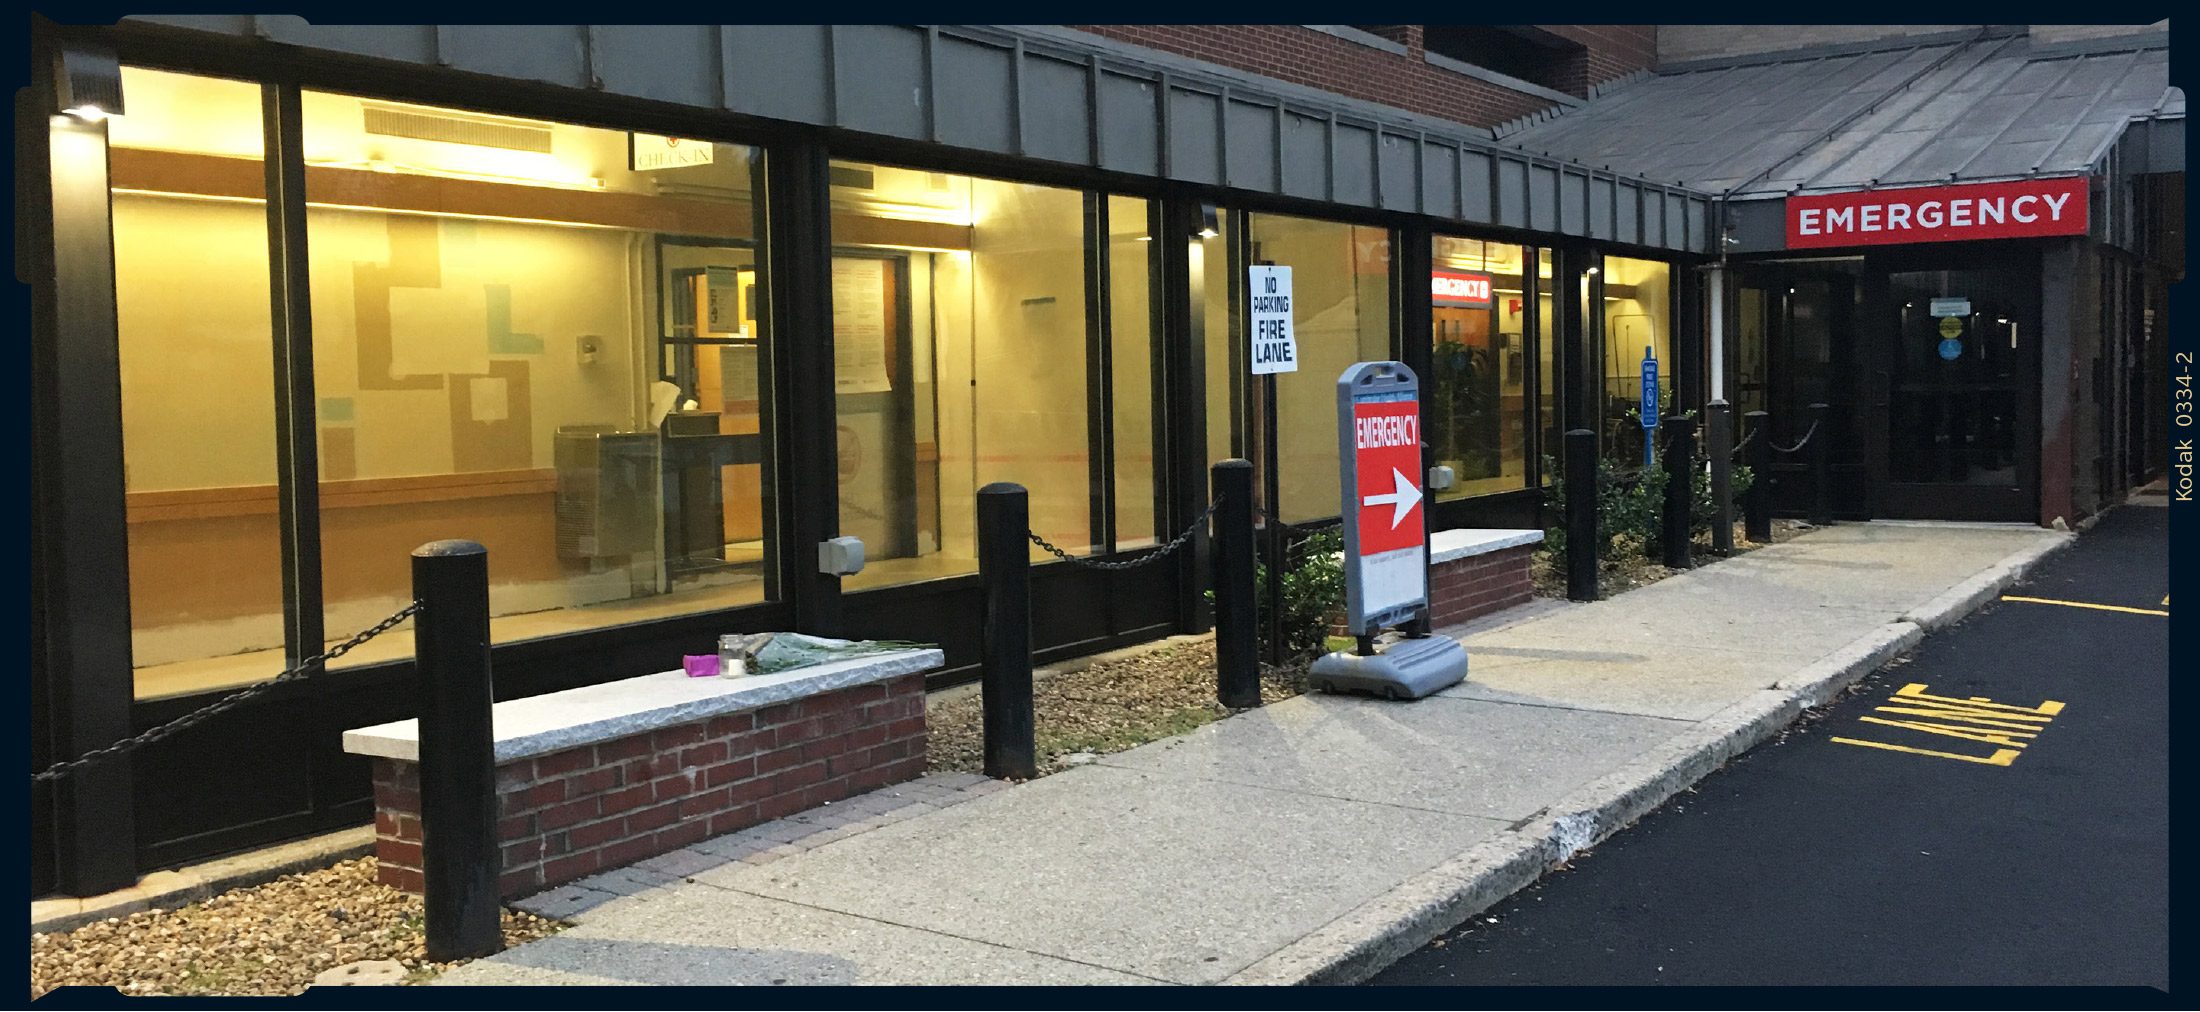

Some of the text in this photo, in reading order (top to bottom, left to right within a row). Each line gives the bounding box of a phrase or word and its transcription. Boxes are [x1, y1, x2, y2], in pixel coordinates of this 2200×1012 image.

[1799, 192, 2071, 235] EMERGENCY
[1265, 277, 1277, 294] NO
[1253, 296, 1289, 313] PARKING
[1259, 320, 1285, 340] FIRE
[1256, 342, 1293, 363] LANE
[1356, 415, 1417, 449] EMERGENCY
[1829, 686, 2066, 767] LANE
